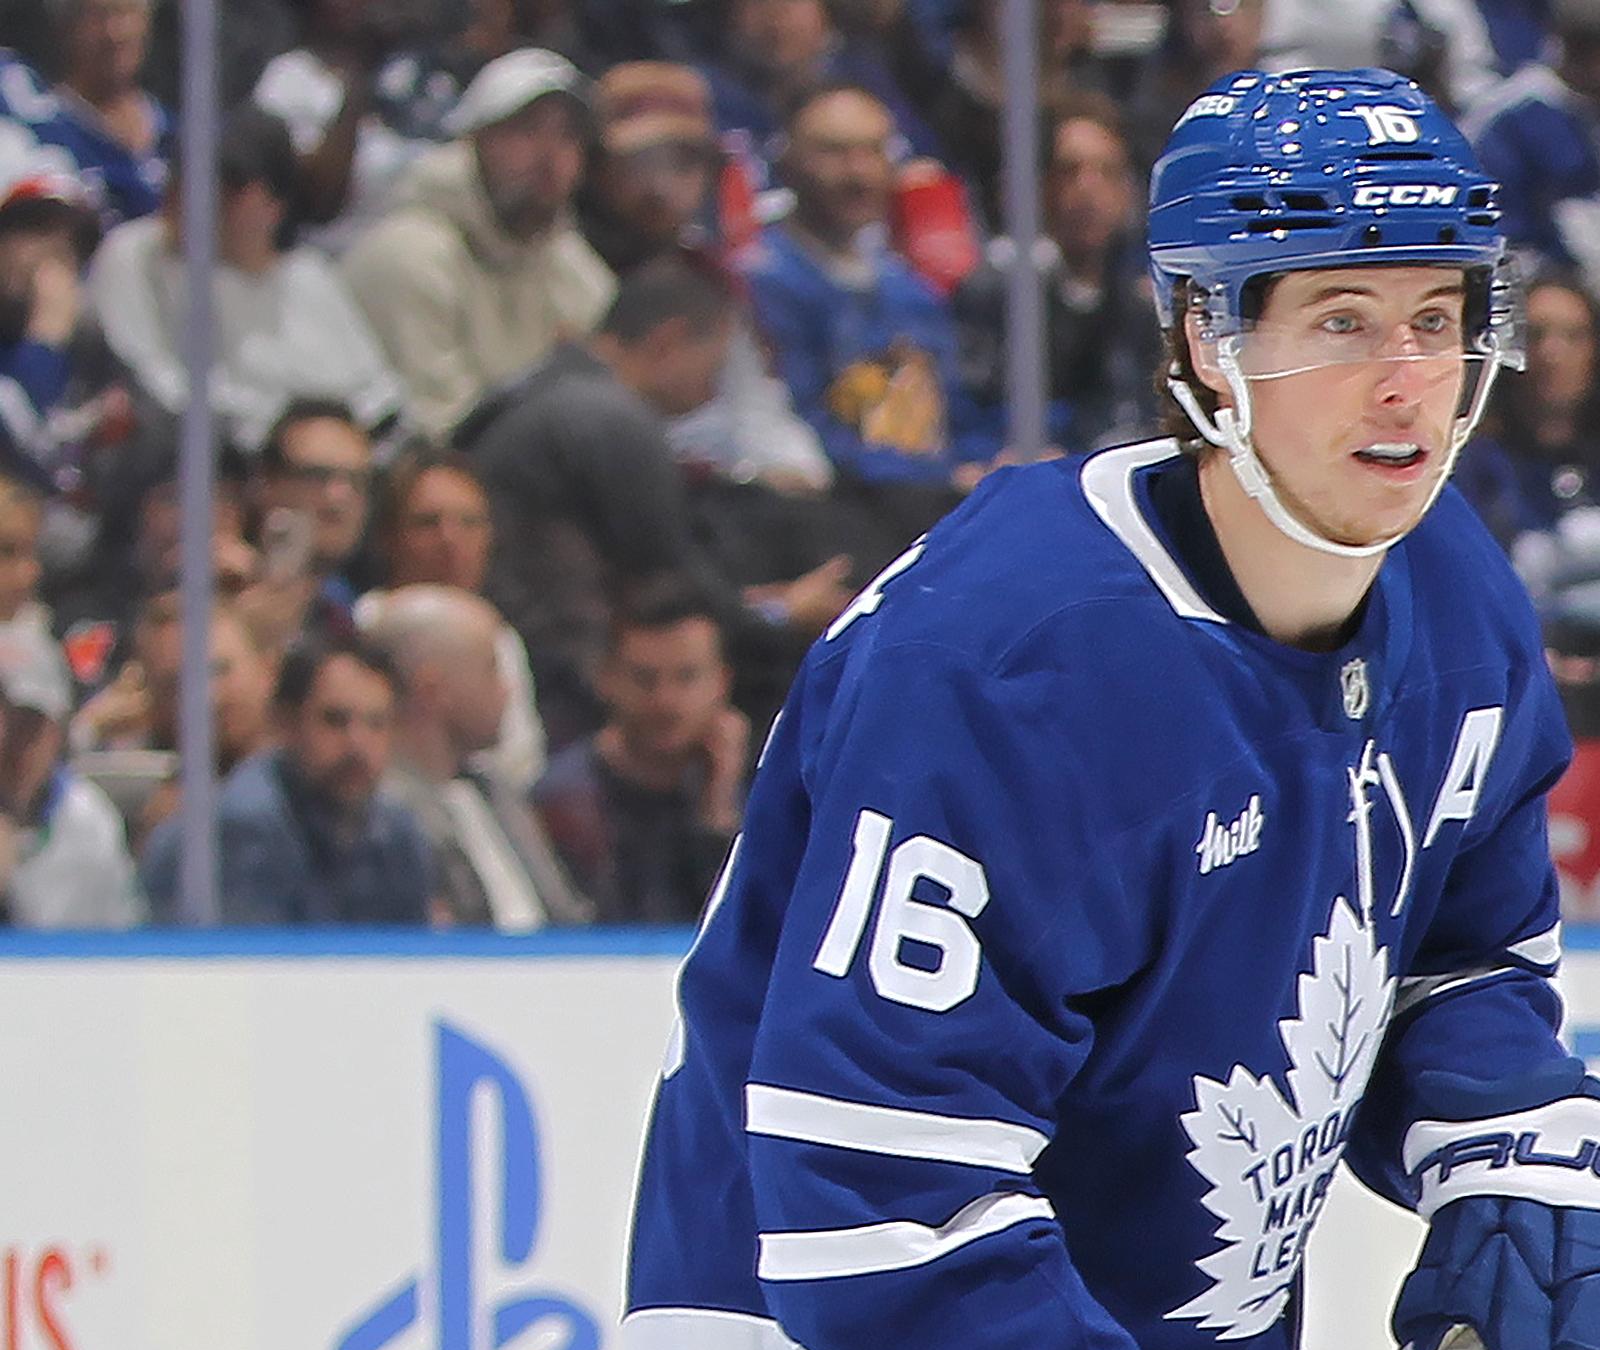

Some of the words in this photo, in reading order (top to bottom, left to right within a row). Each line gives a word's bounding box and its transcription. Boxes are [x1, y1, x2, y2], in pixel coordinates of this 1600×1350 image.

[1352, 105, 1419, 145] 16
[1352, 185, 1459, 207] CCM
[1426, 707, 1503, 848] A
[812, 808, 990, 1013] 16
